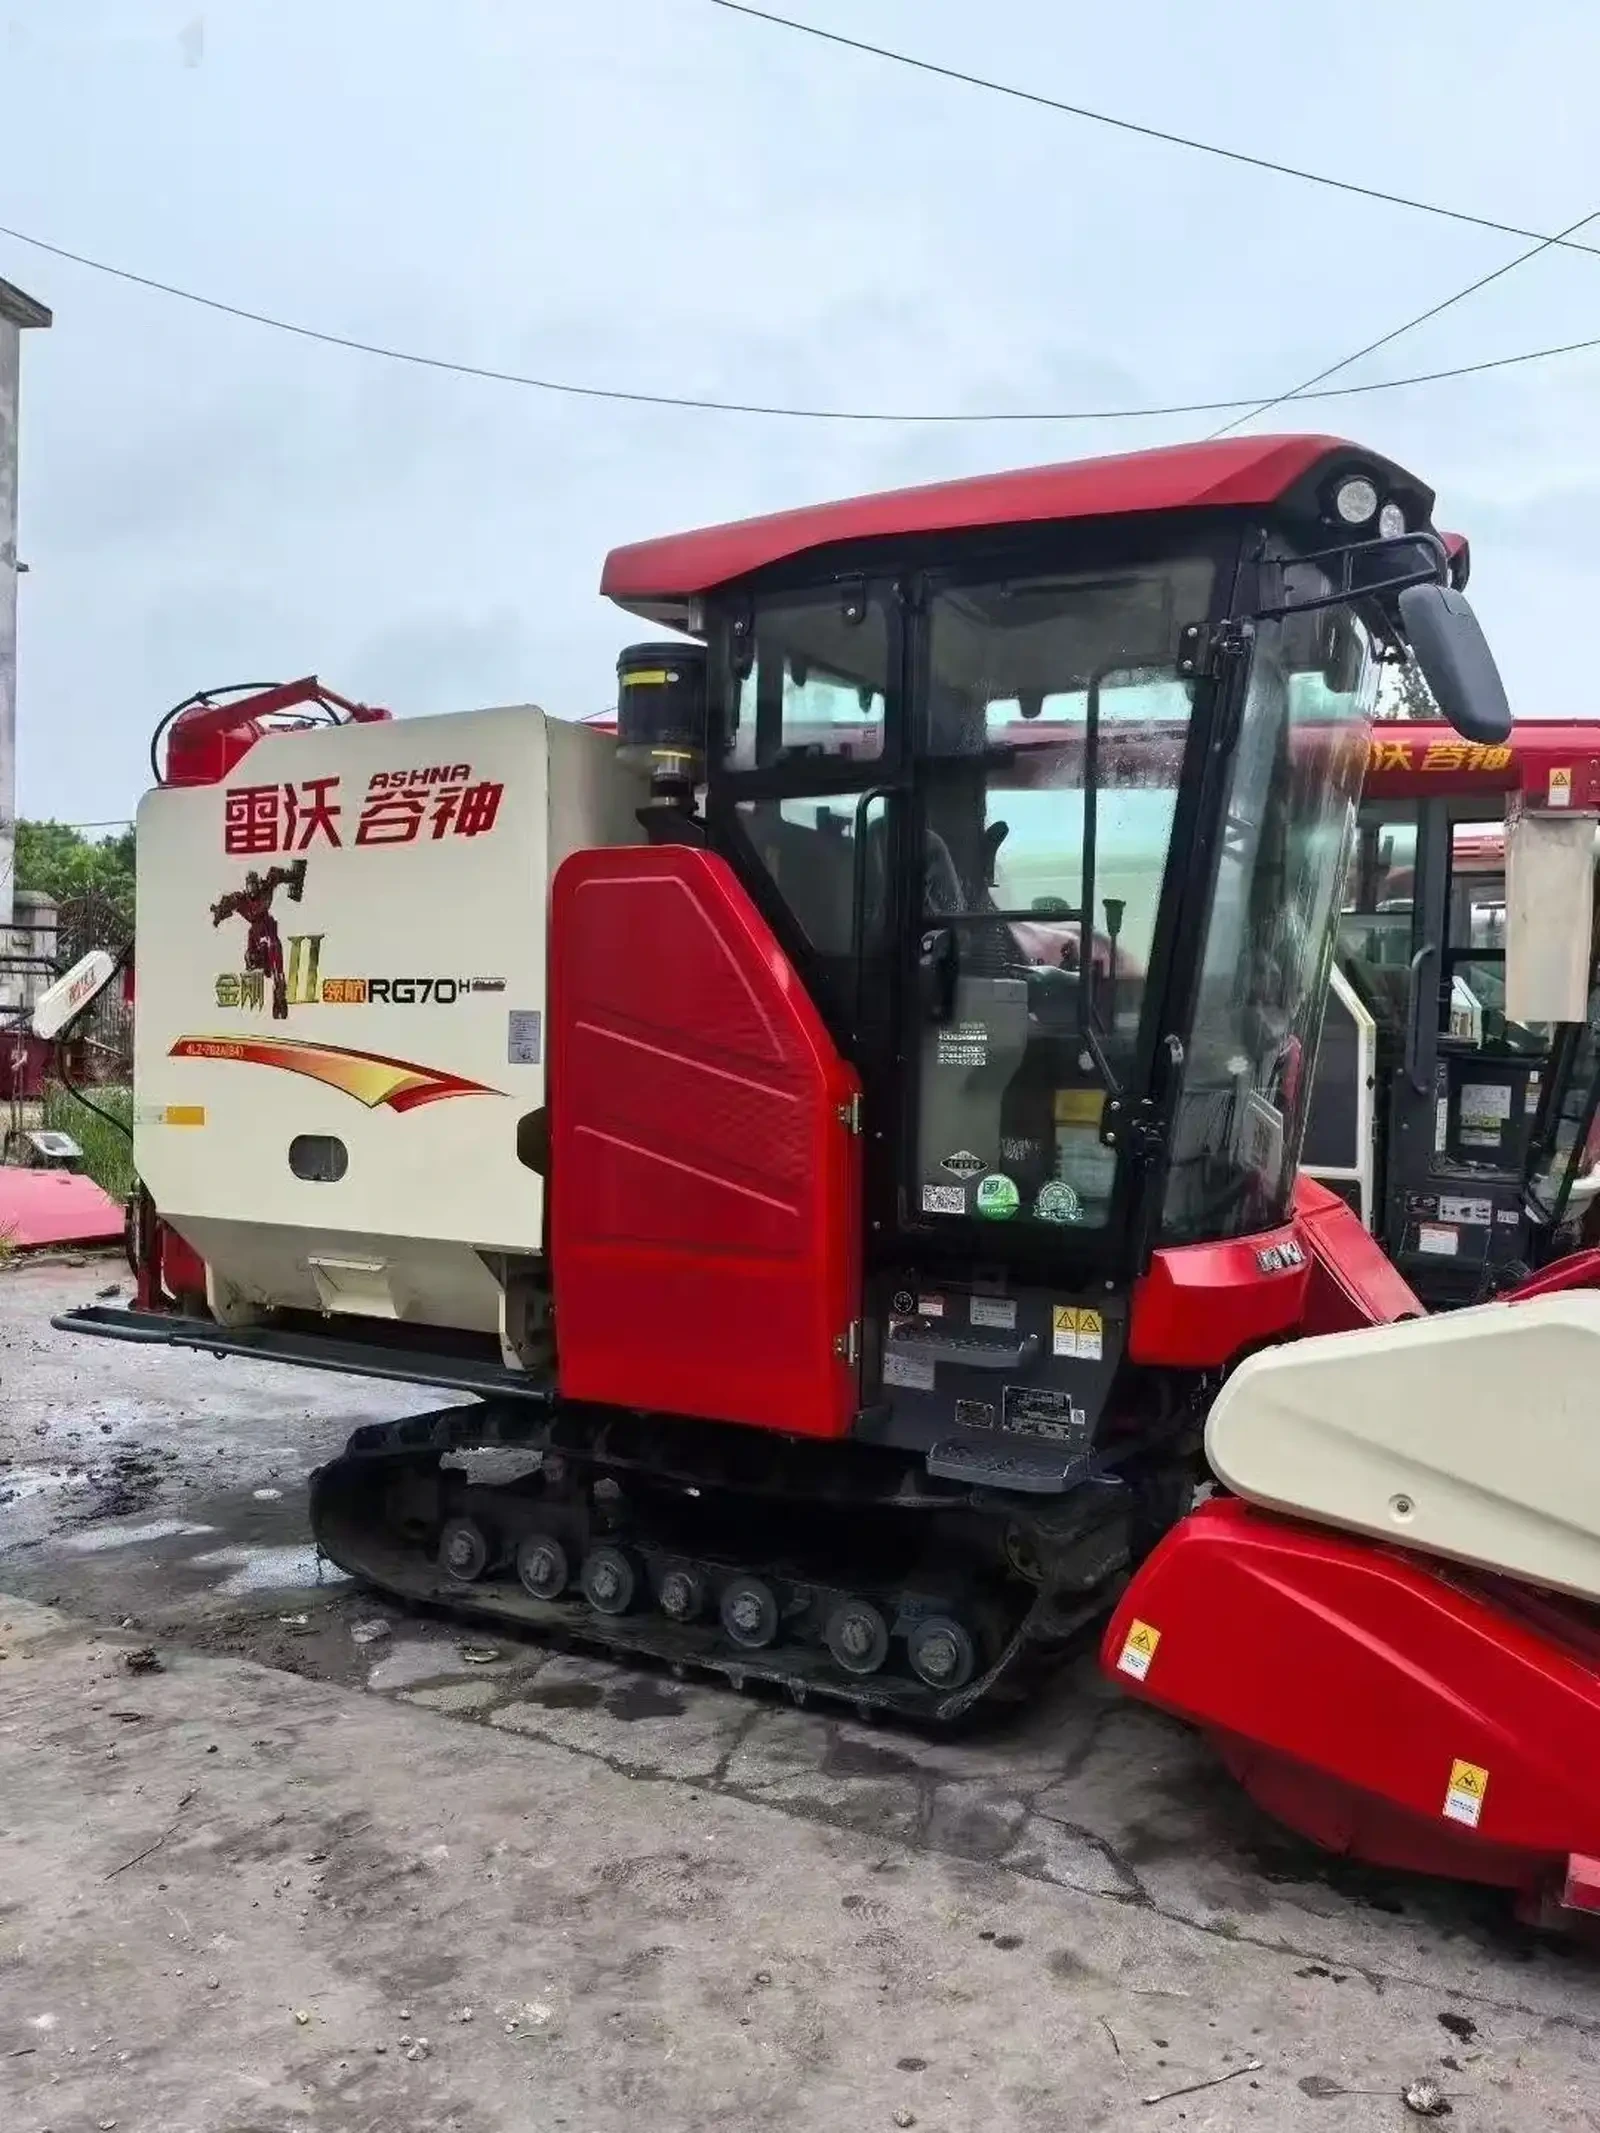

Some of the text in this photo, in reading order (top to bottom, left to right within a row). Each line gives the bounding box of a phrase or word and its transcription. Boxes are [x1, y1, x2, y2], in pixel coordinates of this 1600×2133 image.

[368, 764, 471, 790] ASHNA
[225, 776, 504, 855] 雷沃 谷神
